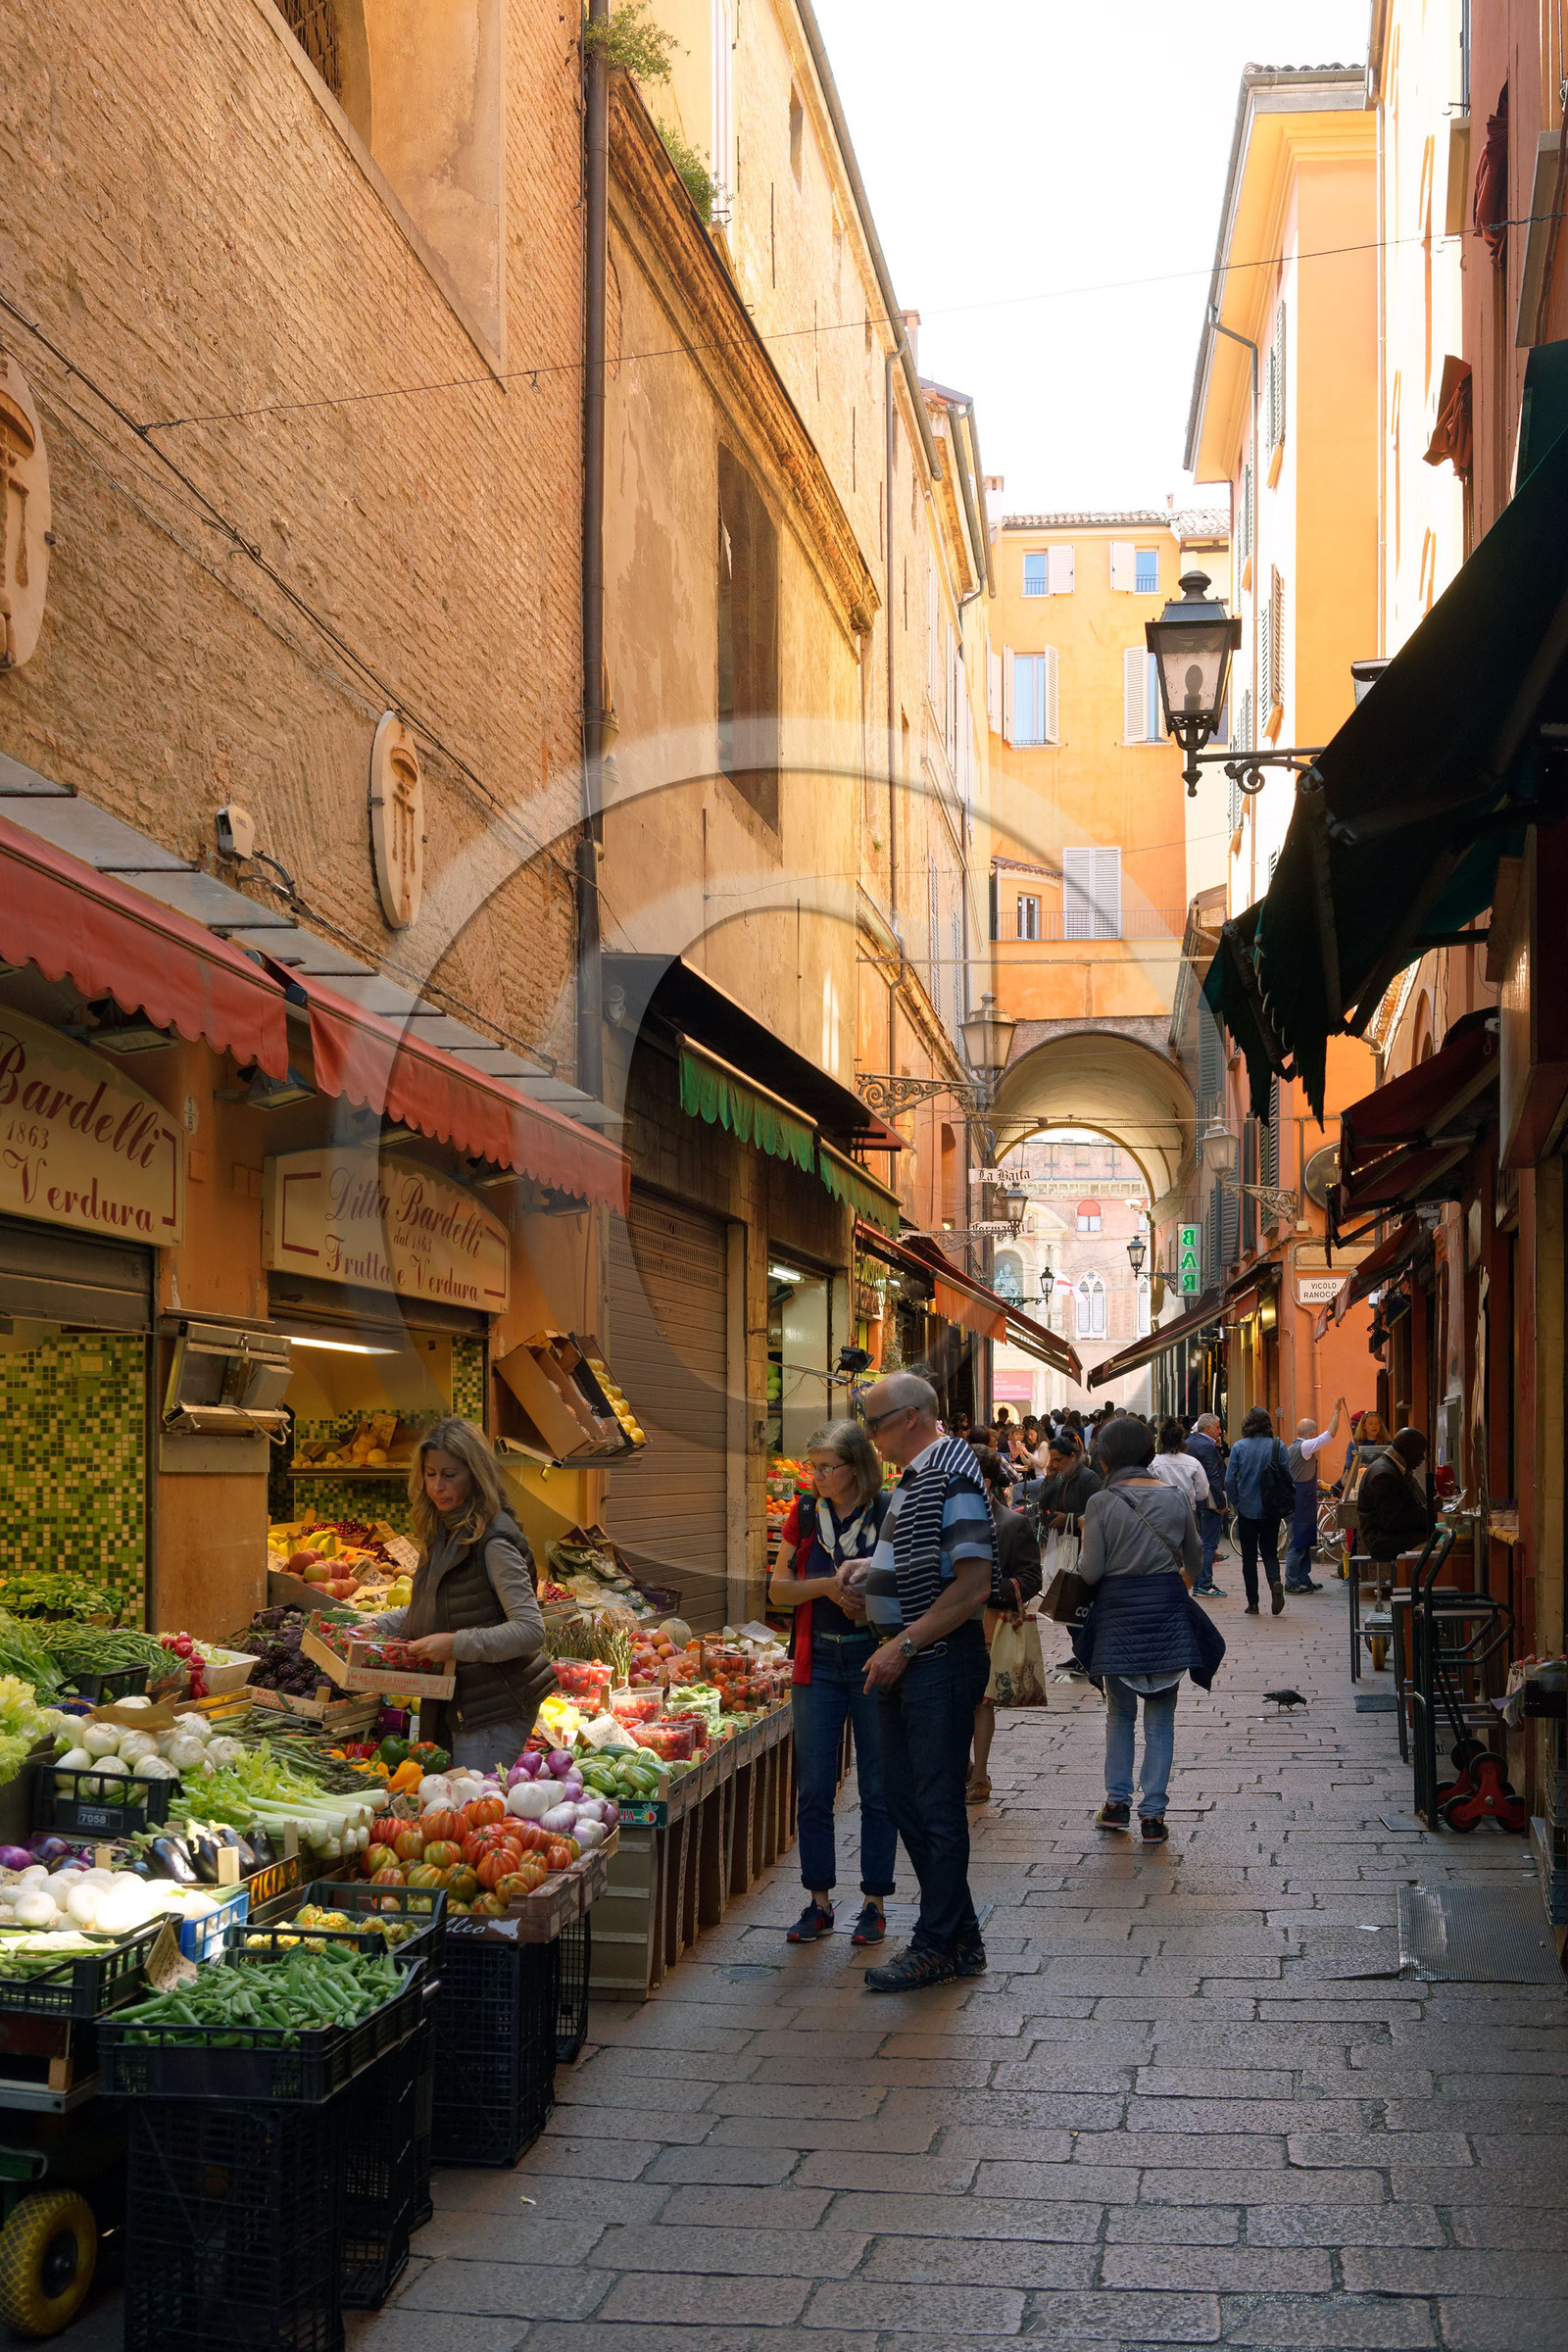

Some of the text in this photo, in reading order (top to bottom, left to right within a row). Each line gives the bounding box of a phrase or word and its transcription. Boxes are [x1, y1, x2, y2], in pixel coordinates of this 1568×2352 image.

[7, 1120, 49, 1151] 1863
[978, 1168, 1031, 1182] La Baita
[2, 1149, 156, 1233] Verdura
[324, 1166, 484, 1259] Ditta Bardelli
[393, 1227, 432, 1253] dal 1863
[324, 1233, 479, 1302] Frutta e Verdura
[80, 1813, 107, 1825] 7058
